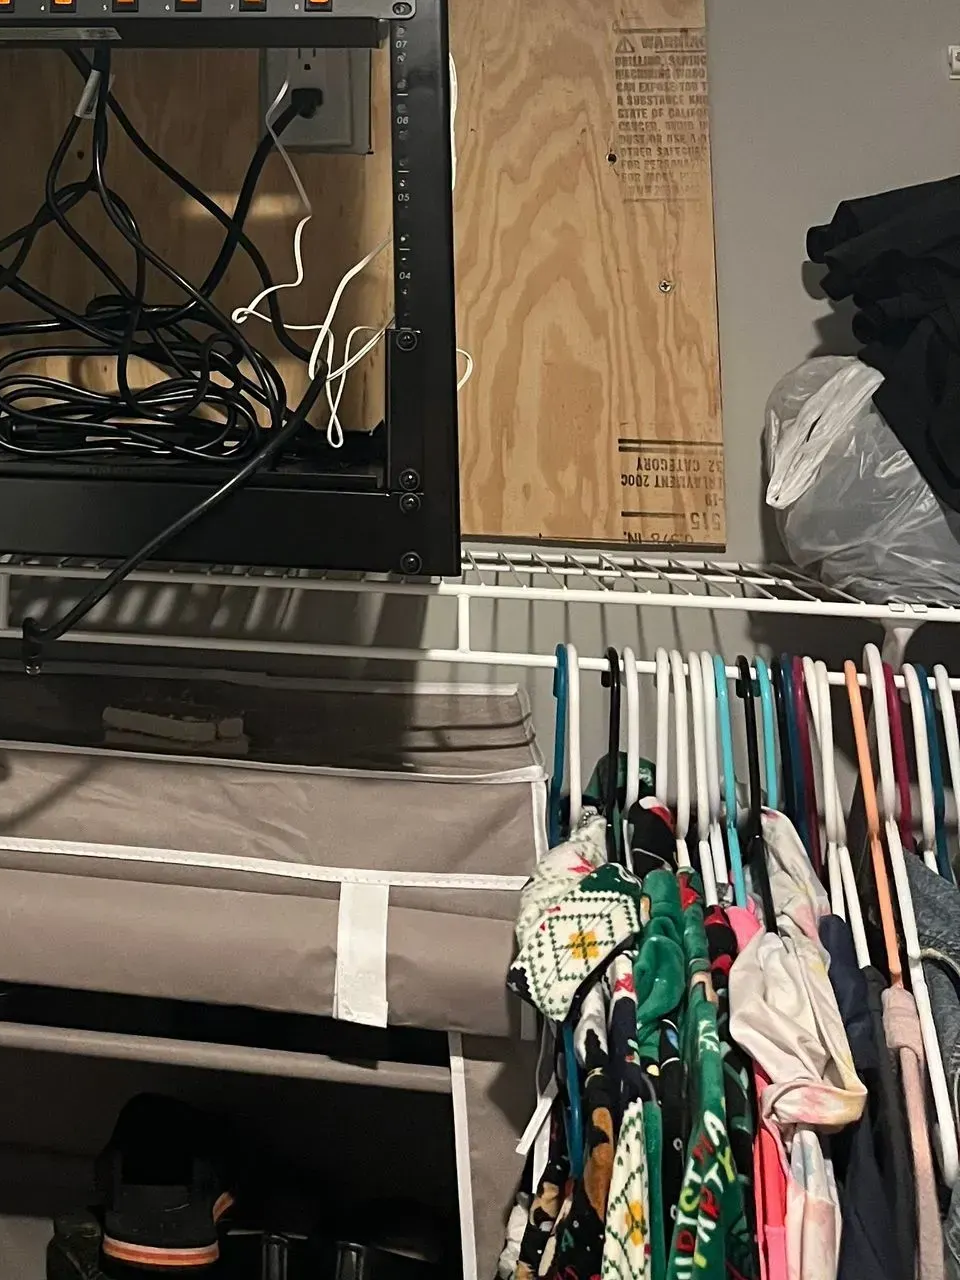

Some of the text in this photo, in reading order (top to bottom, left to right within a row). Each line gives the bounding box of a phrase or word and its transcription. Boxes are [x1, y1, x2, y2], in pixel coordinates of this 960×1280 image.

[395, 41, 408, 49] 07
[617, 108, 648, 119] STATE
[651, 108, 665, 119] OF
[396, 116, 409, 125] 06
[397, 193, 410, 202] 05
[399, 272, 411, 280] 04
[636, 456, 700, 471] CATEGORY
